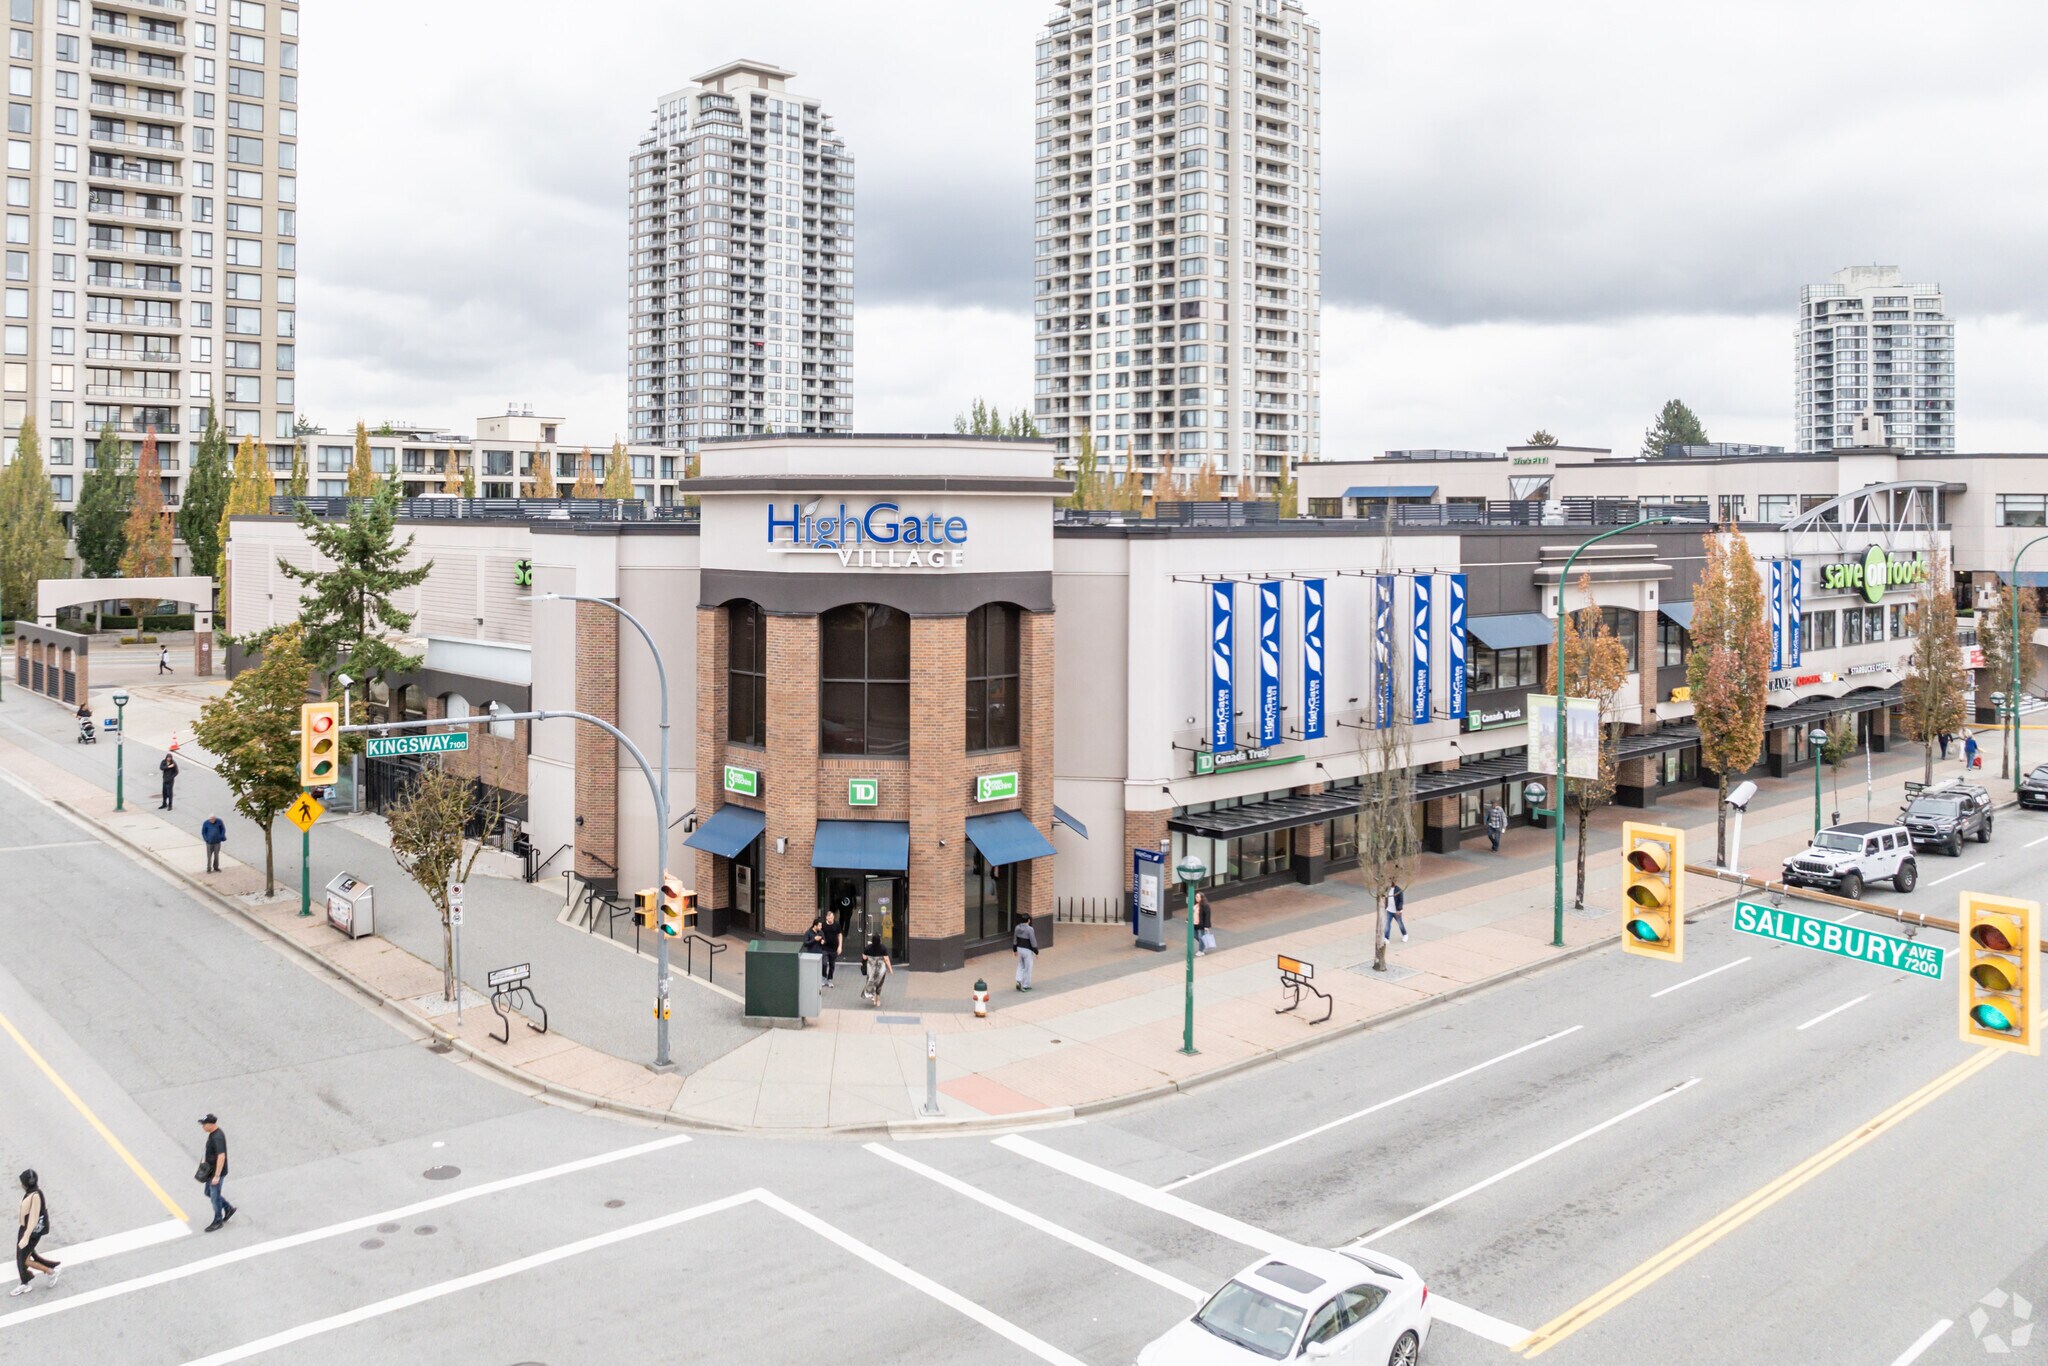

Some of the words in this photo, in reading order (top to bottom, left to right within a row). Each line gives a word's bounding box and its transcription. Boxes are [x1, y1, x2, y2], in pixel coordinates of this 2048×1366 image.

[767, 502, 968, 549] HighGate
[838, 549, 963, 568] VILLAGE
[1825, 563, 1864, 590] save
[1867, 561, 1887, 587] on
[1887, 551, 1929, 585] foods
[1851, 664, 1875, 676] STARBUCKS
[1217, 689, 1227, 745] HighGate
[1265, 686, 1274, 740] HighGate
[1308, 680, 1317, 733] HighGate
[1470, 713, 1480, 726] TD
[1481, 711, 1504, 723] Canada
[1504, 708, 1521, 719] Trust
[369, 735, 450, 755] KINGSWAY
[449, 741, 466, 749] 7100
[1200, 755, 1212, 769] TD
[1215, 750, 1246, 765] Canada
[1248, 747, 1270, 760] Trust
[852, 784, 875, 800] TD
[1738, 905, 1907, 966] SALISBURY
[1908, 945, 1936, 962] AVE
[1904, 956, 1938, 976] 7200
